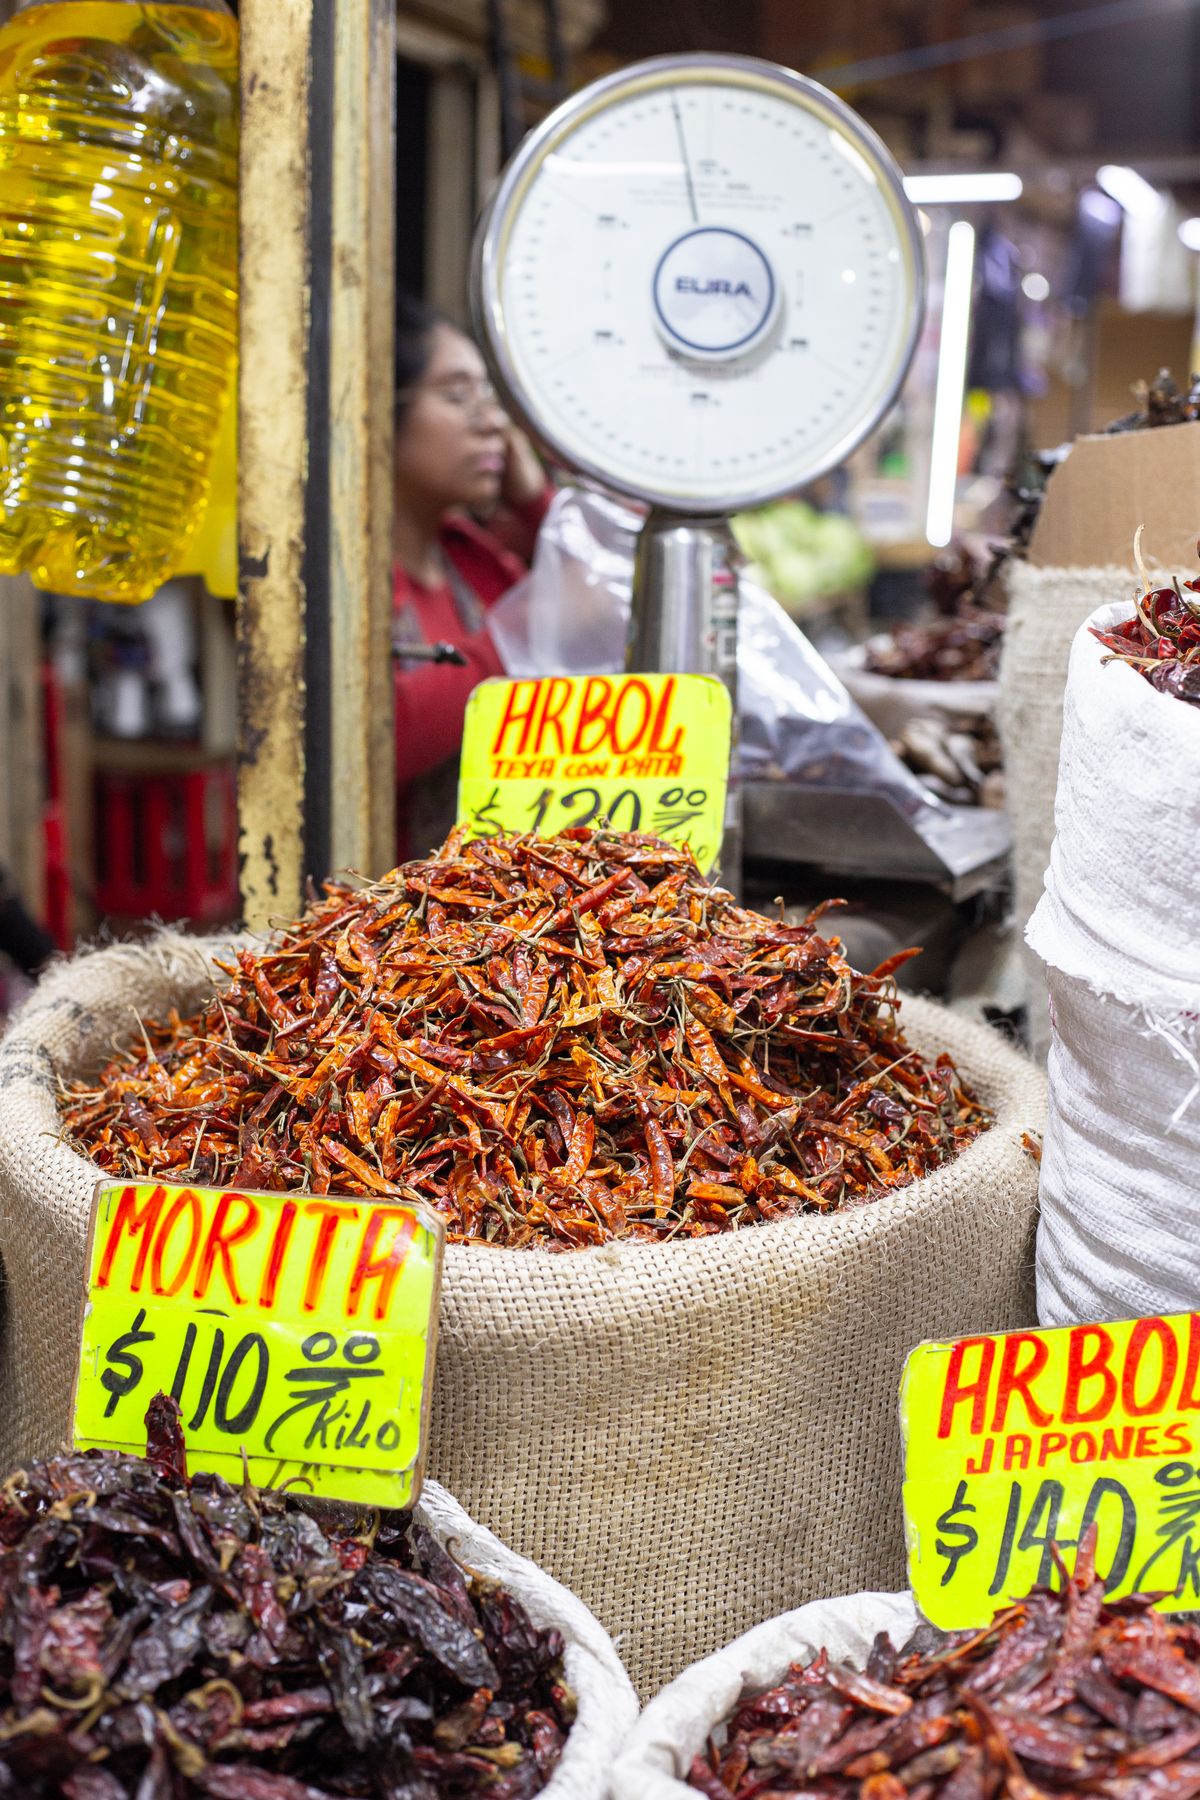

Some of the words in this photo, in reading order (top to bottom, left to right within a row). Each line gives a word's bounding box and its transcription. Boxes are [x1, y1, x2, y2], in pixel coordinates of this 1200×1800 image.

[492, 675, 684, 755] ARBOL
[564, 763, 609, 778] CON
[618, 755, 683, 777] PATA
[96, 1184, 419, 1320] MORITA
[937, 1311, 1200, 1439] ARBOL
[965, 1422, 1193, 1475] JAPONES
